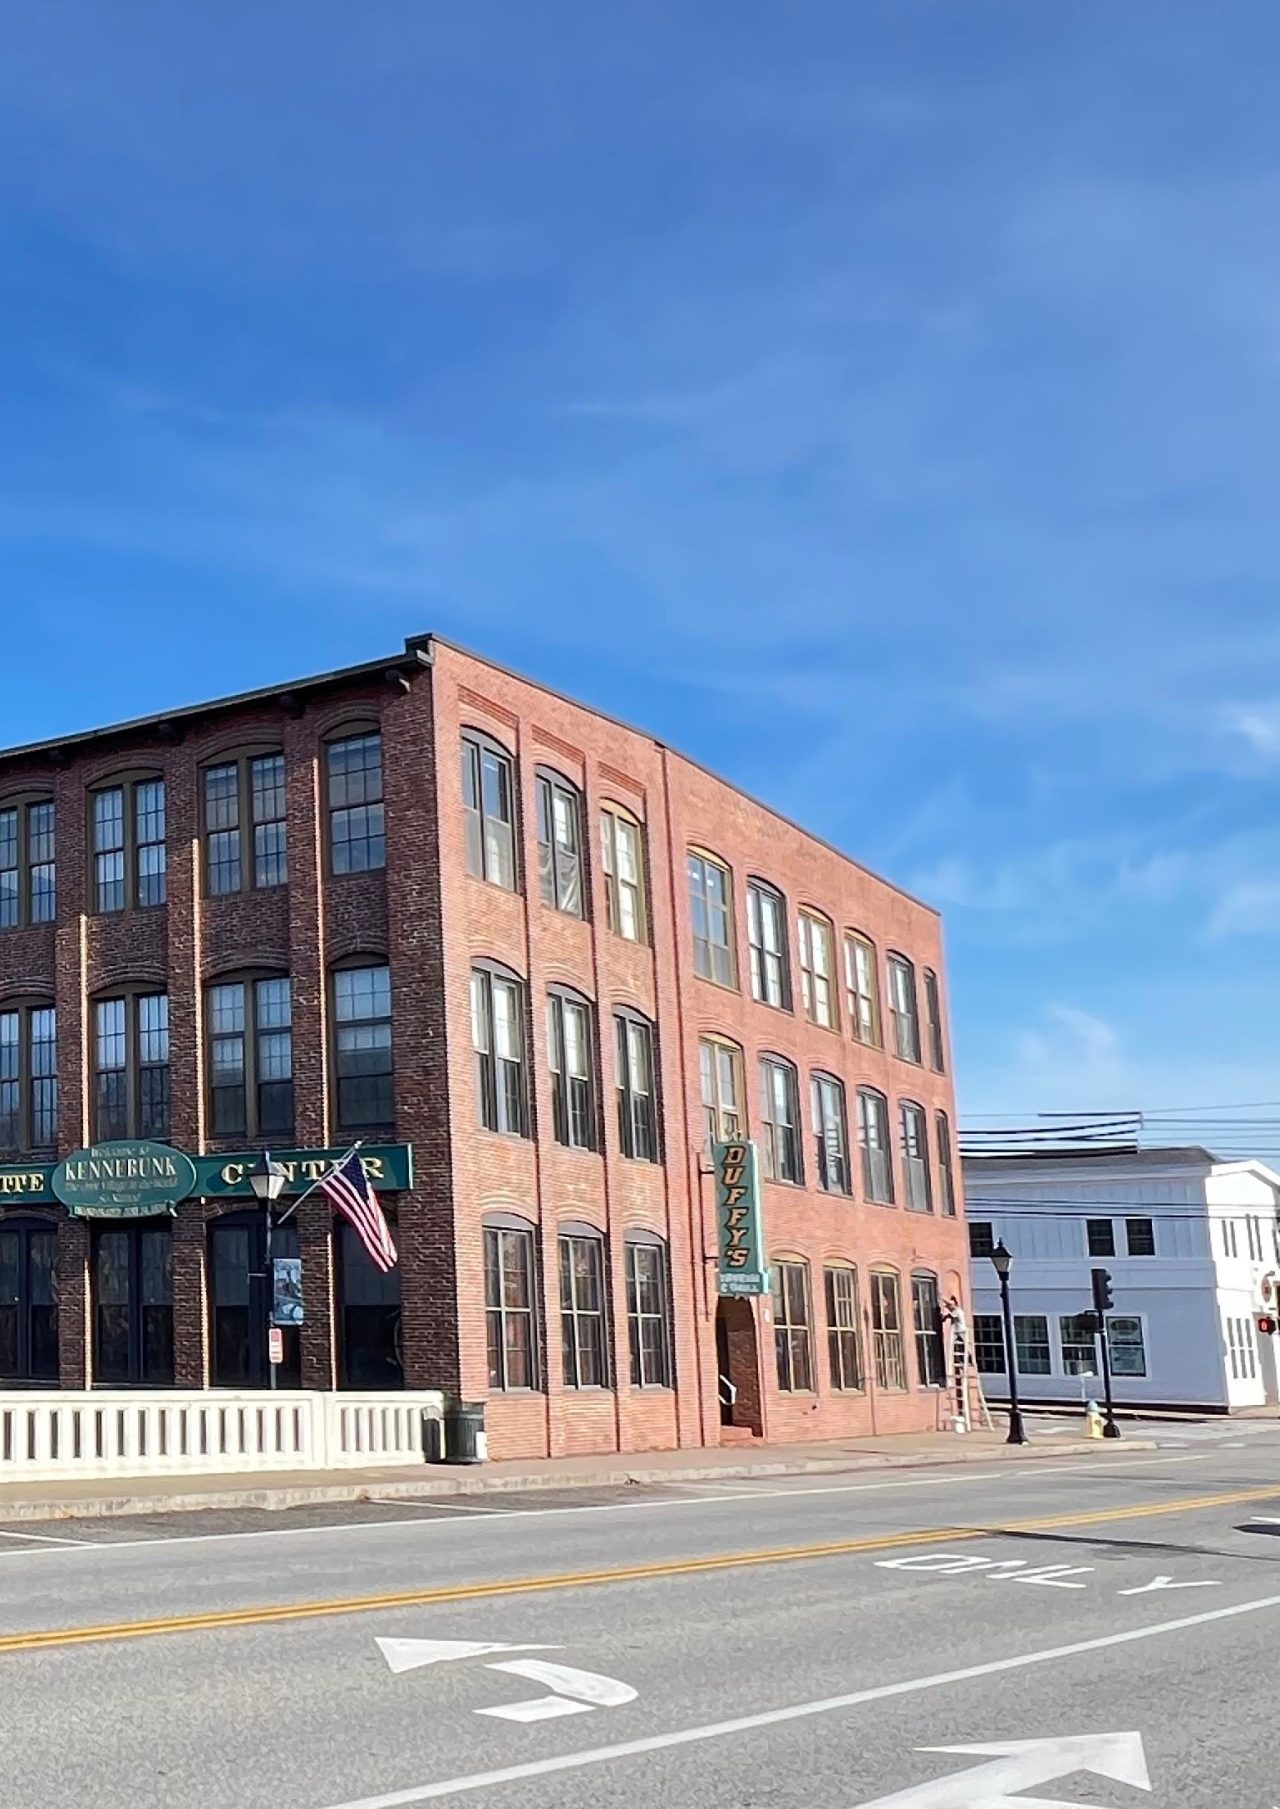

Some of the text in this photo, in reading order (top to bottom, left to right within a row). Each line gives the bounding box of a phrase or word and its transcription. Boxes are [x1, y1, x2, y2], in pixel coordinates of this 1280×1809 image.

[65, 1156, 176, 1181] KENNEBUNK
[221, 1157, 384, 1185] CNTR
[722, 1146, 750, 1268] DUFFY'S
[874, 1553, 1224, 1596] ONLY
